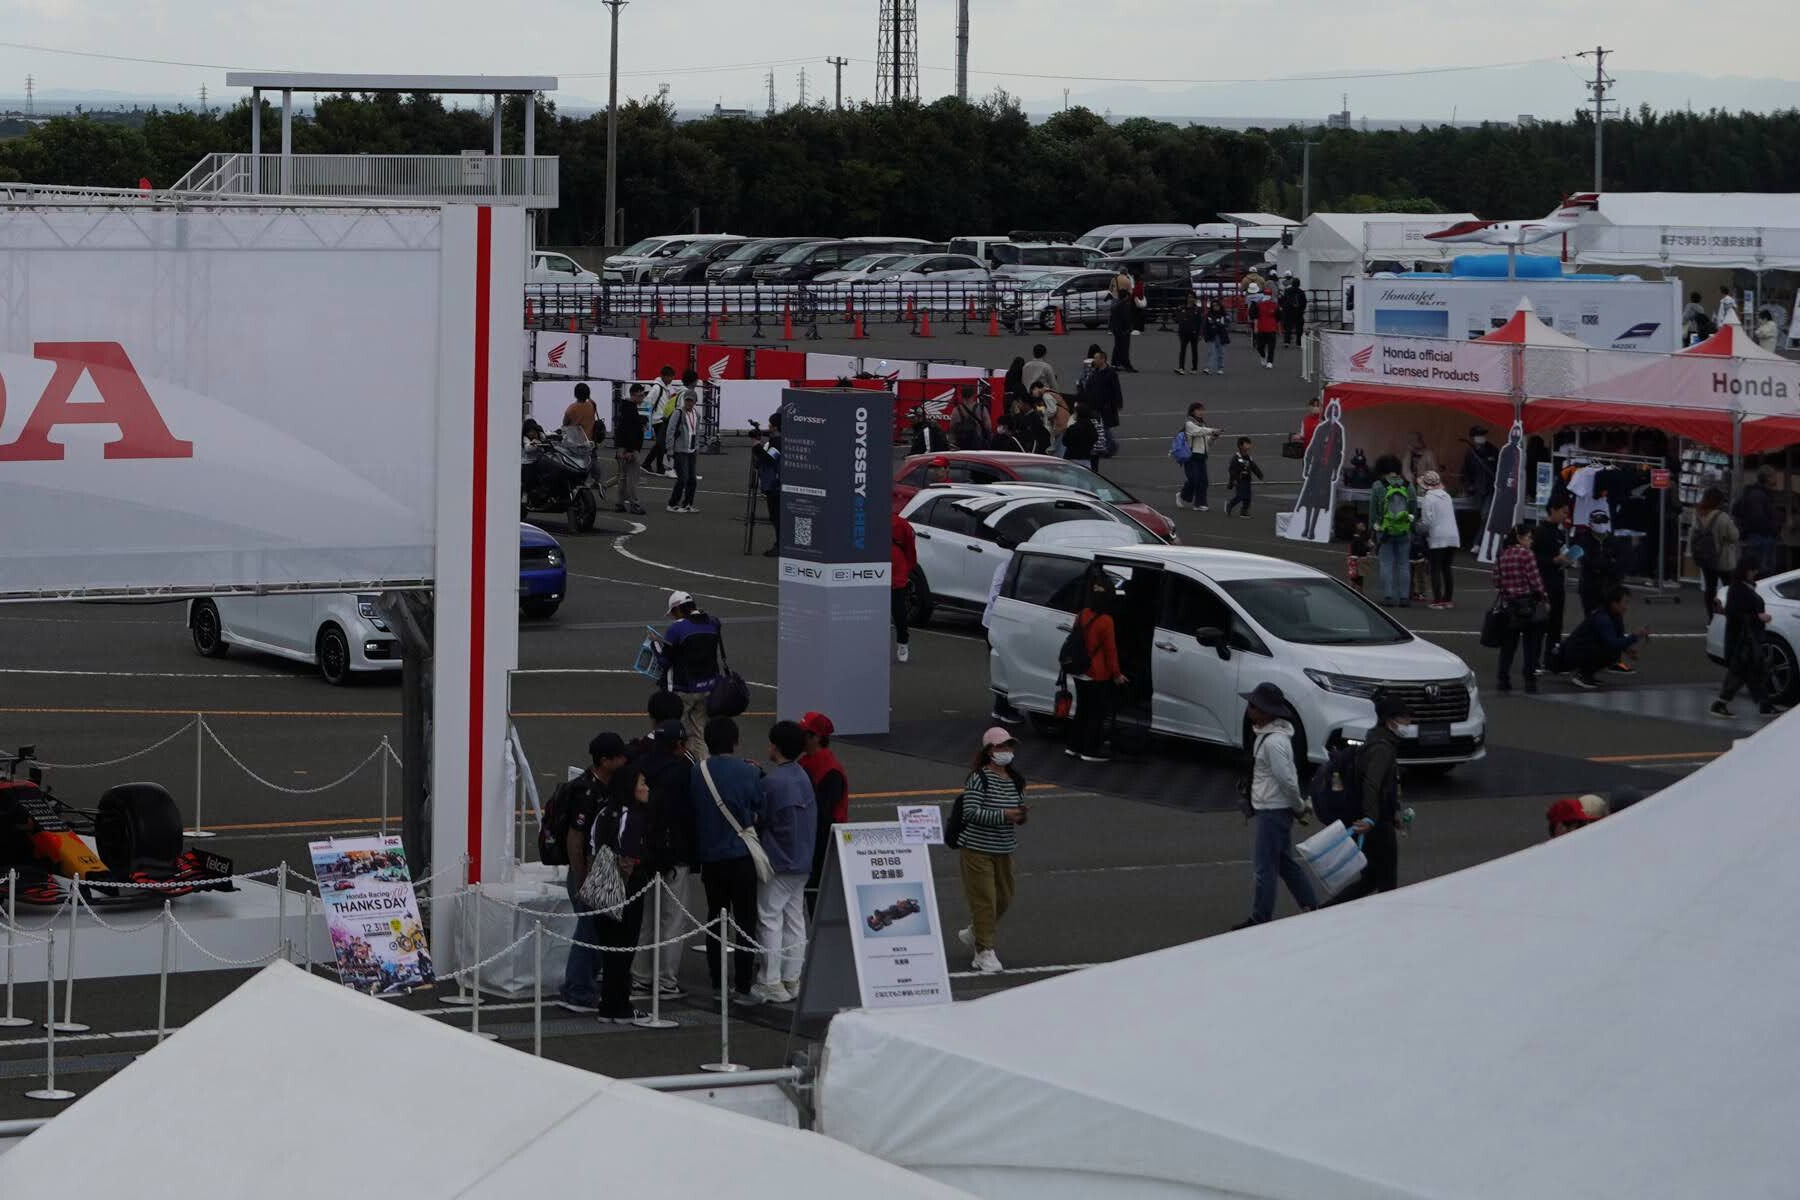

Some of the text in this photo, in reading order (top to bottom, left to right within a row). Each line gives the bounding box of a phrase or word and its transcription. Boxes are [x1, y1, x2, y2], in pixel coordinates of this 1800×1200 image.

[1383, 346, 1453, 362] Honda official
[1383, 363, 1480, 382] Licensed Products
[1711, 372, 1788, 398] Honda
[793, 415, 827, 424] ODYSSEY
[854, 406, 868, 498] ODYSSEY
[784, 564, 823, 579] e:HEV
[833, 569, 885, 580] e:HEV
[333, 897, 407, 913] THANKS DAY
